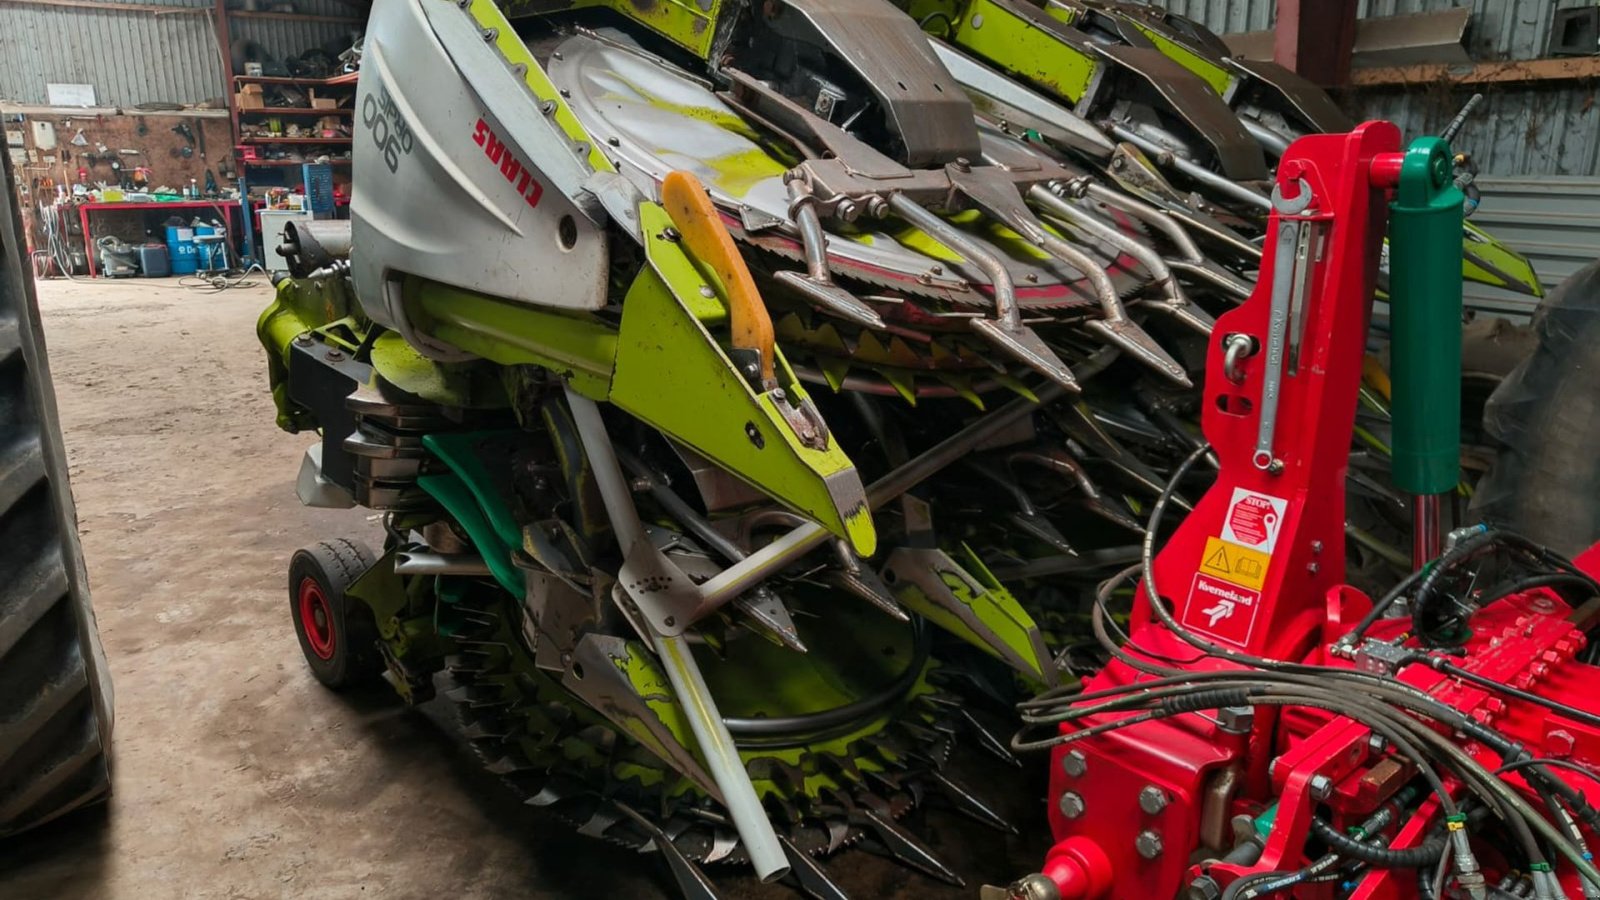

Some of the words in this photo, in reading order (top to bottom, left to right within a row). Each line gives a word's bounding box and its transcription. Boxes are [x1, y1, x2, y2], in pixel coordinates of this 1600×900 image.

[363, 93, 402, 174] 900
[472, 118, 544, 208] CLAAS
[1198, 579, 1253, 606] Kverneland
